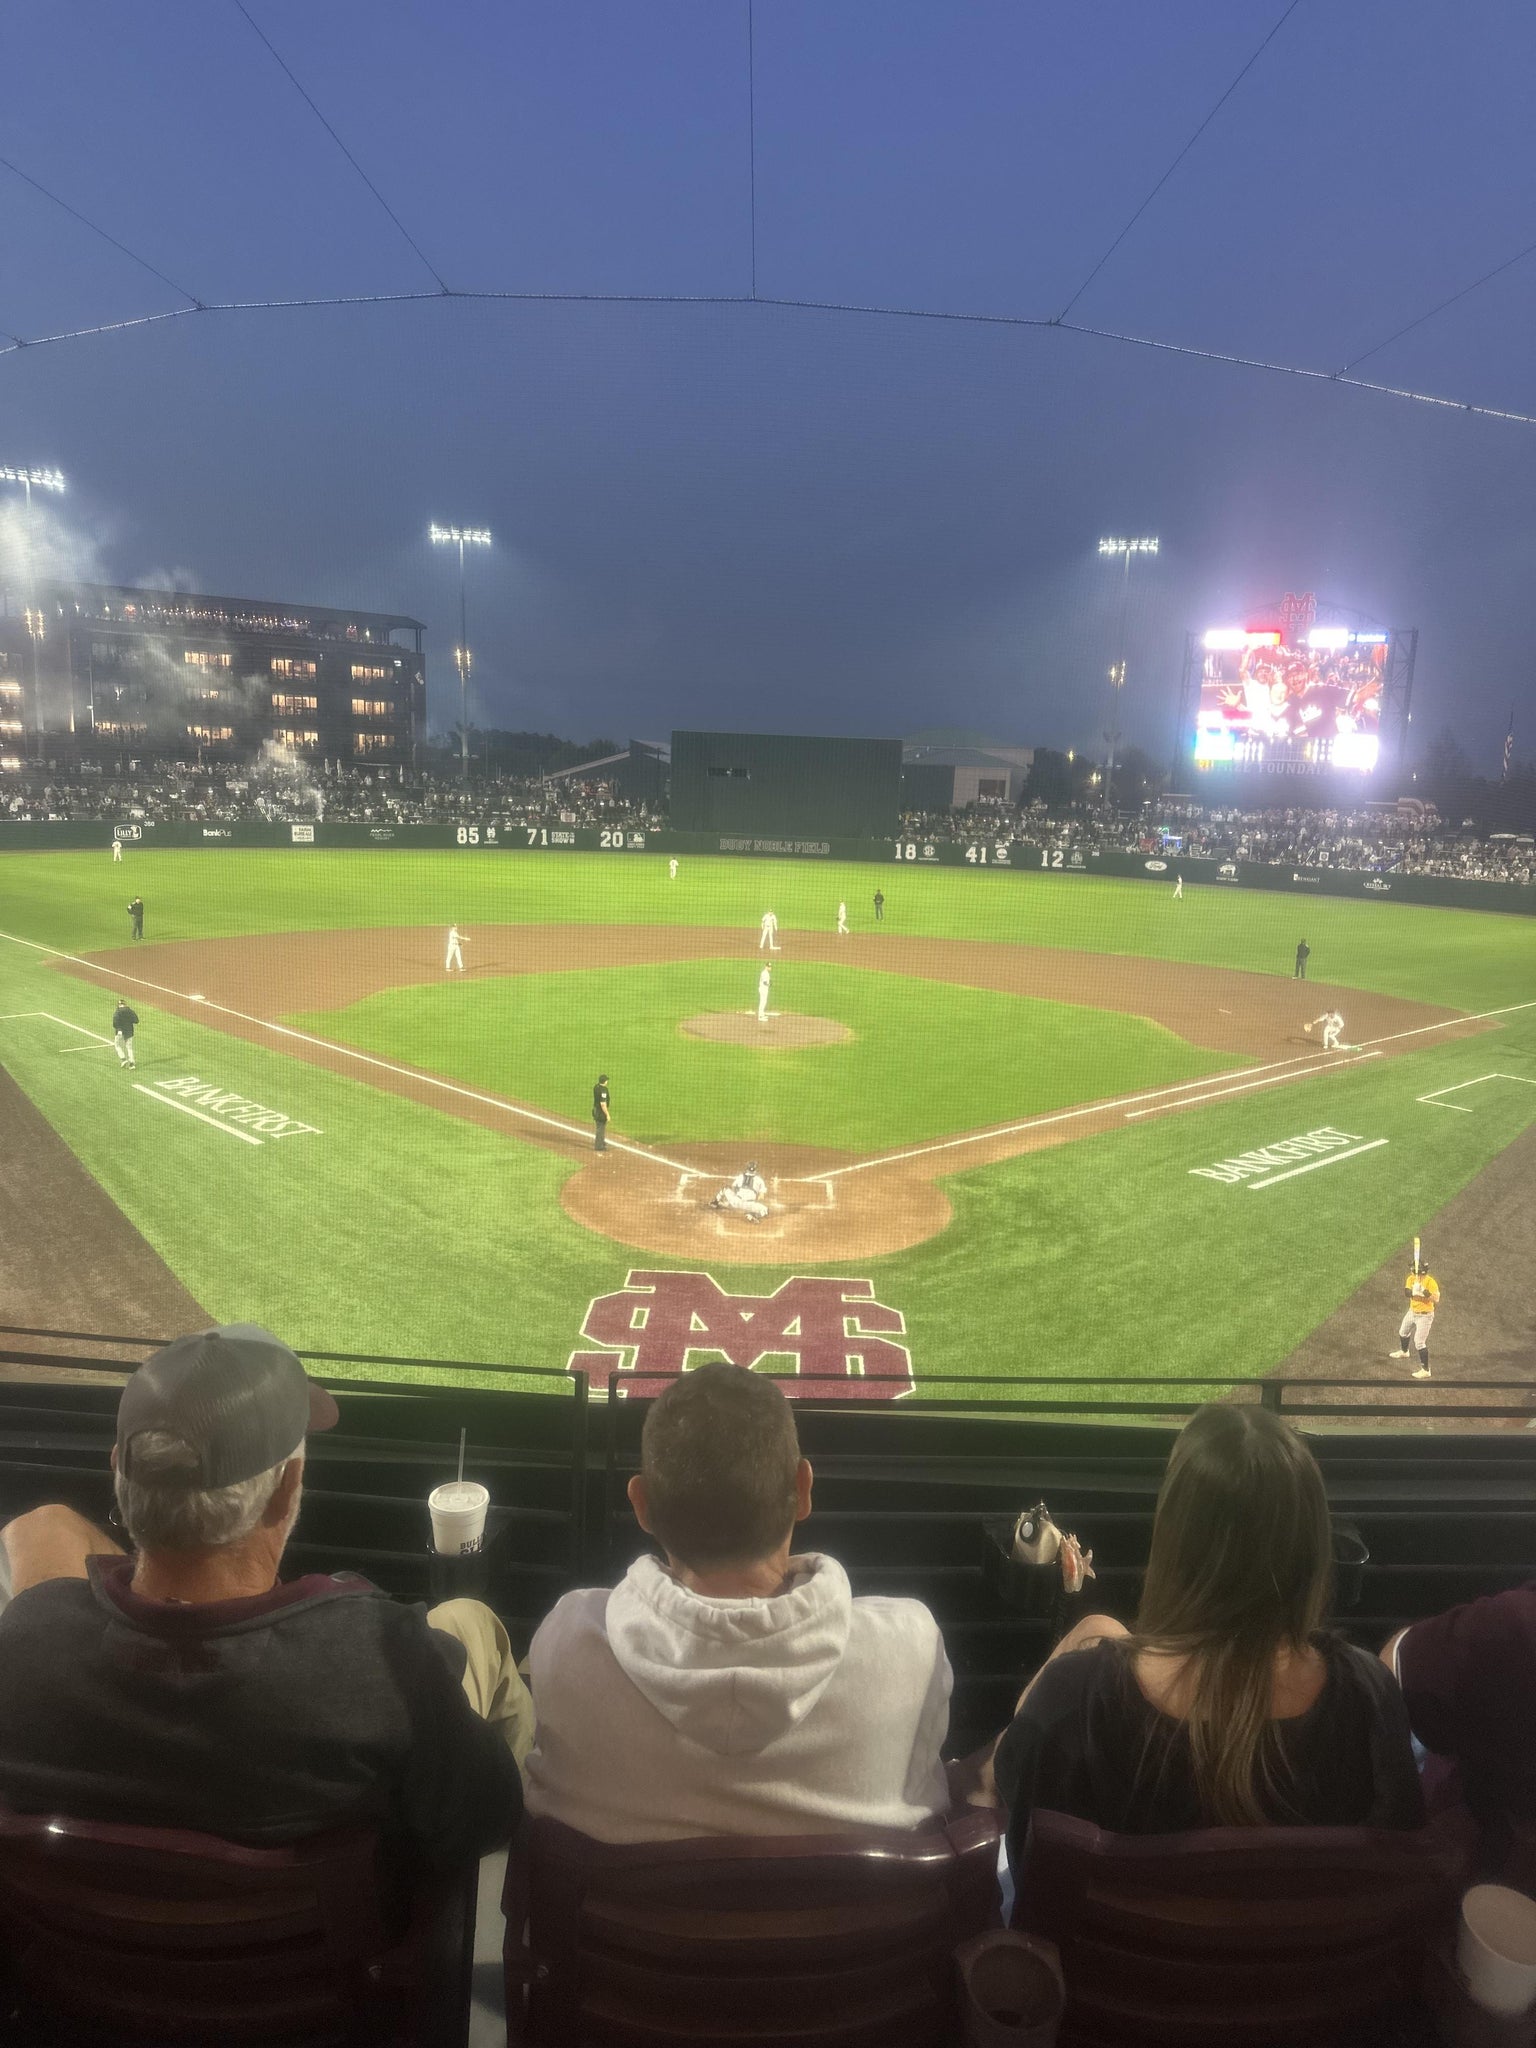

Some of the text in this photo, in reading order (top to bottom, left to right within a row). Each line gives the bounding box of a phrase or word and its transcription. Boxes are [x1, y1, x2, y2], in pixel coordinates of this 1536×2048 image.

[203, 829, 232, 837] BankPlus
[456, 826, 479, 845] 85
[527, 828, 548, 846] 71
[600, 831, 623, 848] 20
[753, 840, 793, 853] NOBLE
[794, 842, 831, 855] FIELD
[895, 843, 917, 861] 18
[965, 846, 987, 864] 41
[1041, 850, 1064, 868] 12
[154, 1076, 324, 1139] BANKFIRST
[1188, 1126, 1363, 1183] BANKFIRST
